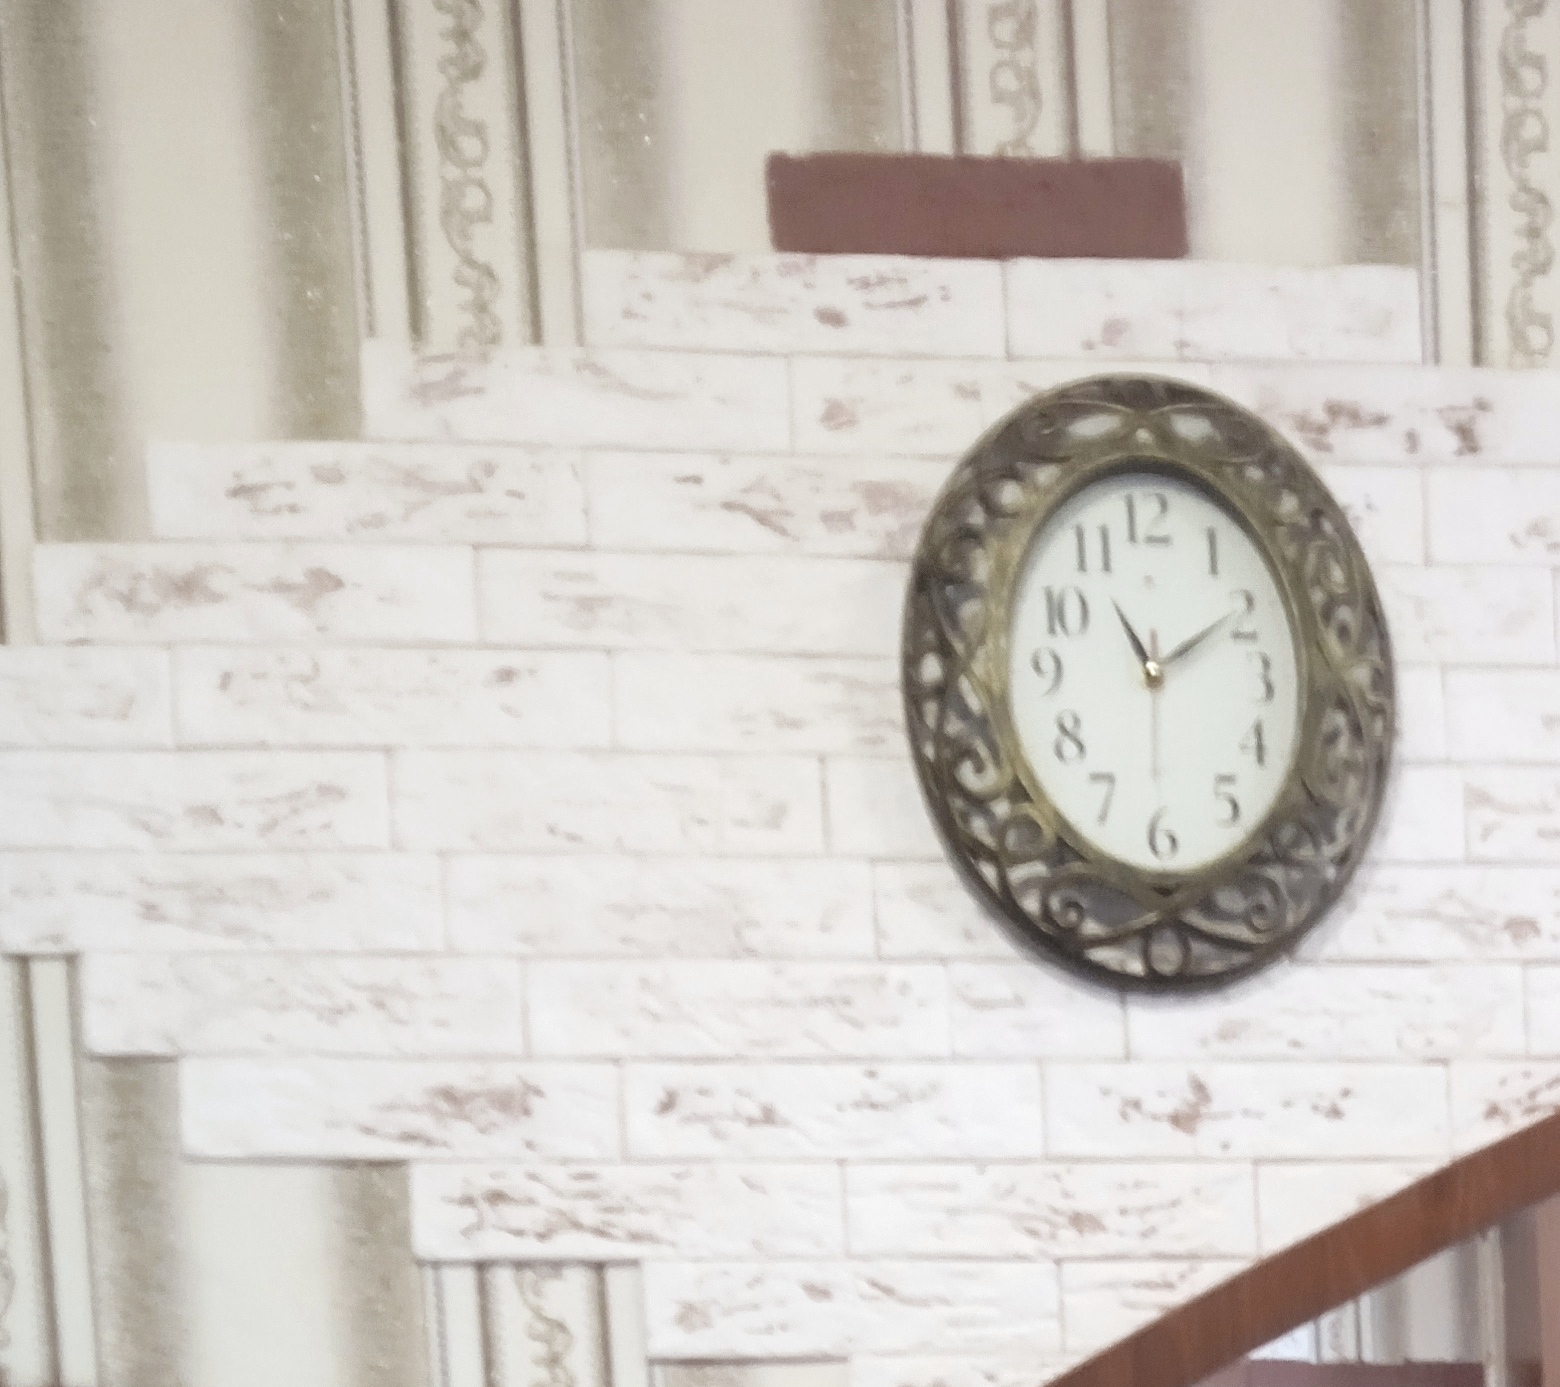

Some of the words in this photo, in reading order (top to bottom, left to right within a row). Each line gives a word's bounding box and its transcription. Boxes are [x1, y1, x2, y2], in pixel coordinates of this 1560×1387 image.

[1124, 492, 1173, 544] 12
[1073, 524, 1112, 574] 11
[1203, 525, 1219, 577] 1
[1043, 584, 1090, 638] 10
[1229, 588, 1259, 643] 2
[1030, 646, 1063, 697] 9
[1250, 650, 1275, 704] 3
[1052, 708, 1087, 765] 8
[1239, 718, 1267, 767] 4
[1089, 771, 1116, 825] 7
[1214, 772, 1241, 827] 5
[1146, 806, 1179, 861] 6
